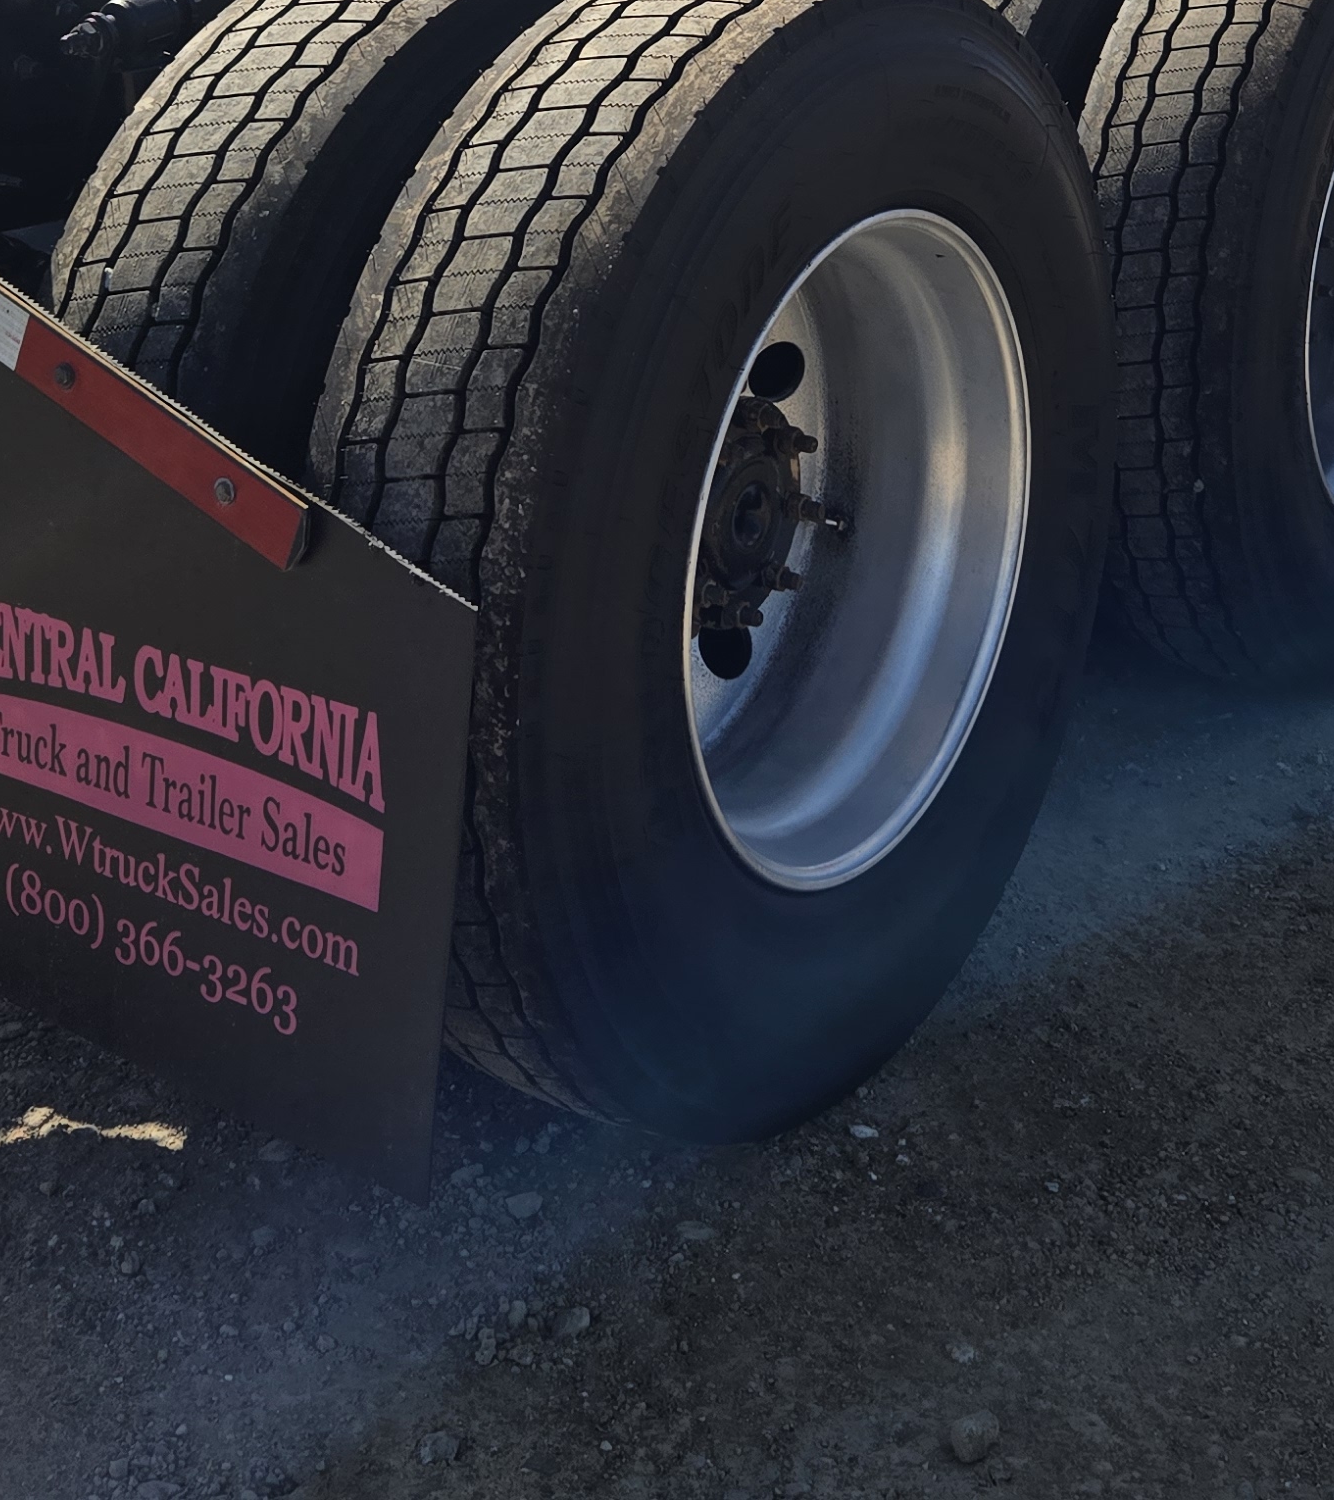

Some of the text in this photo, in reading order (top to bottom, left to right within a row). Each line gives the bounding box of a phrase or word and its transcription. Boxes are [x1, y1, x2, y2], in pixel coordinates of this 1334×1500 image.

[75, 745, 131, 799] and
[141, 752, 251, 840] Trailer
[260, 795, 346, 876] Sales
[134, 644, 386, 814] CALIFORNIA
[5, 862, 299, 1036] (800) 366-3263
